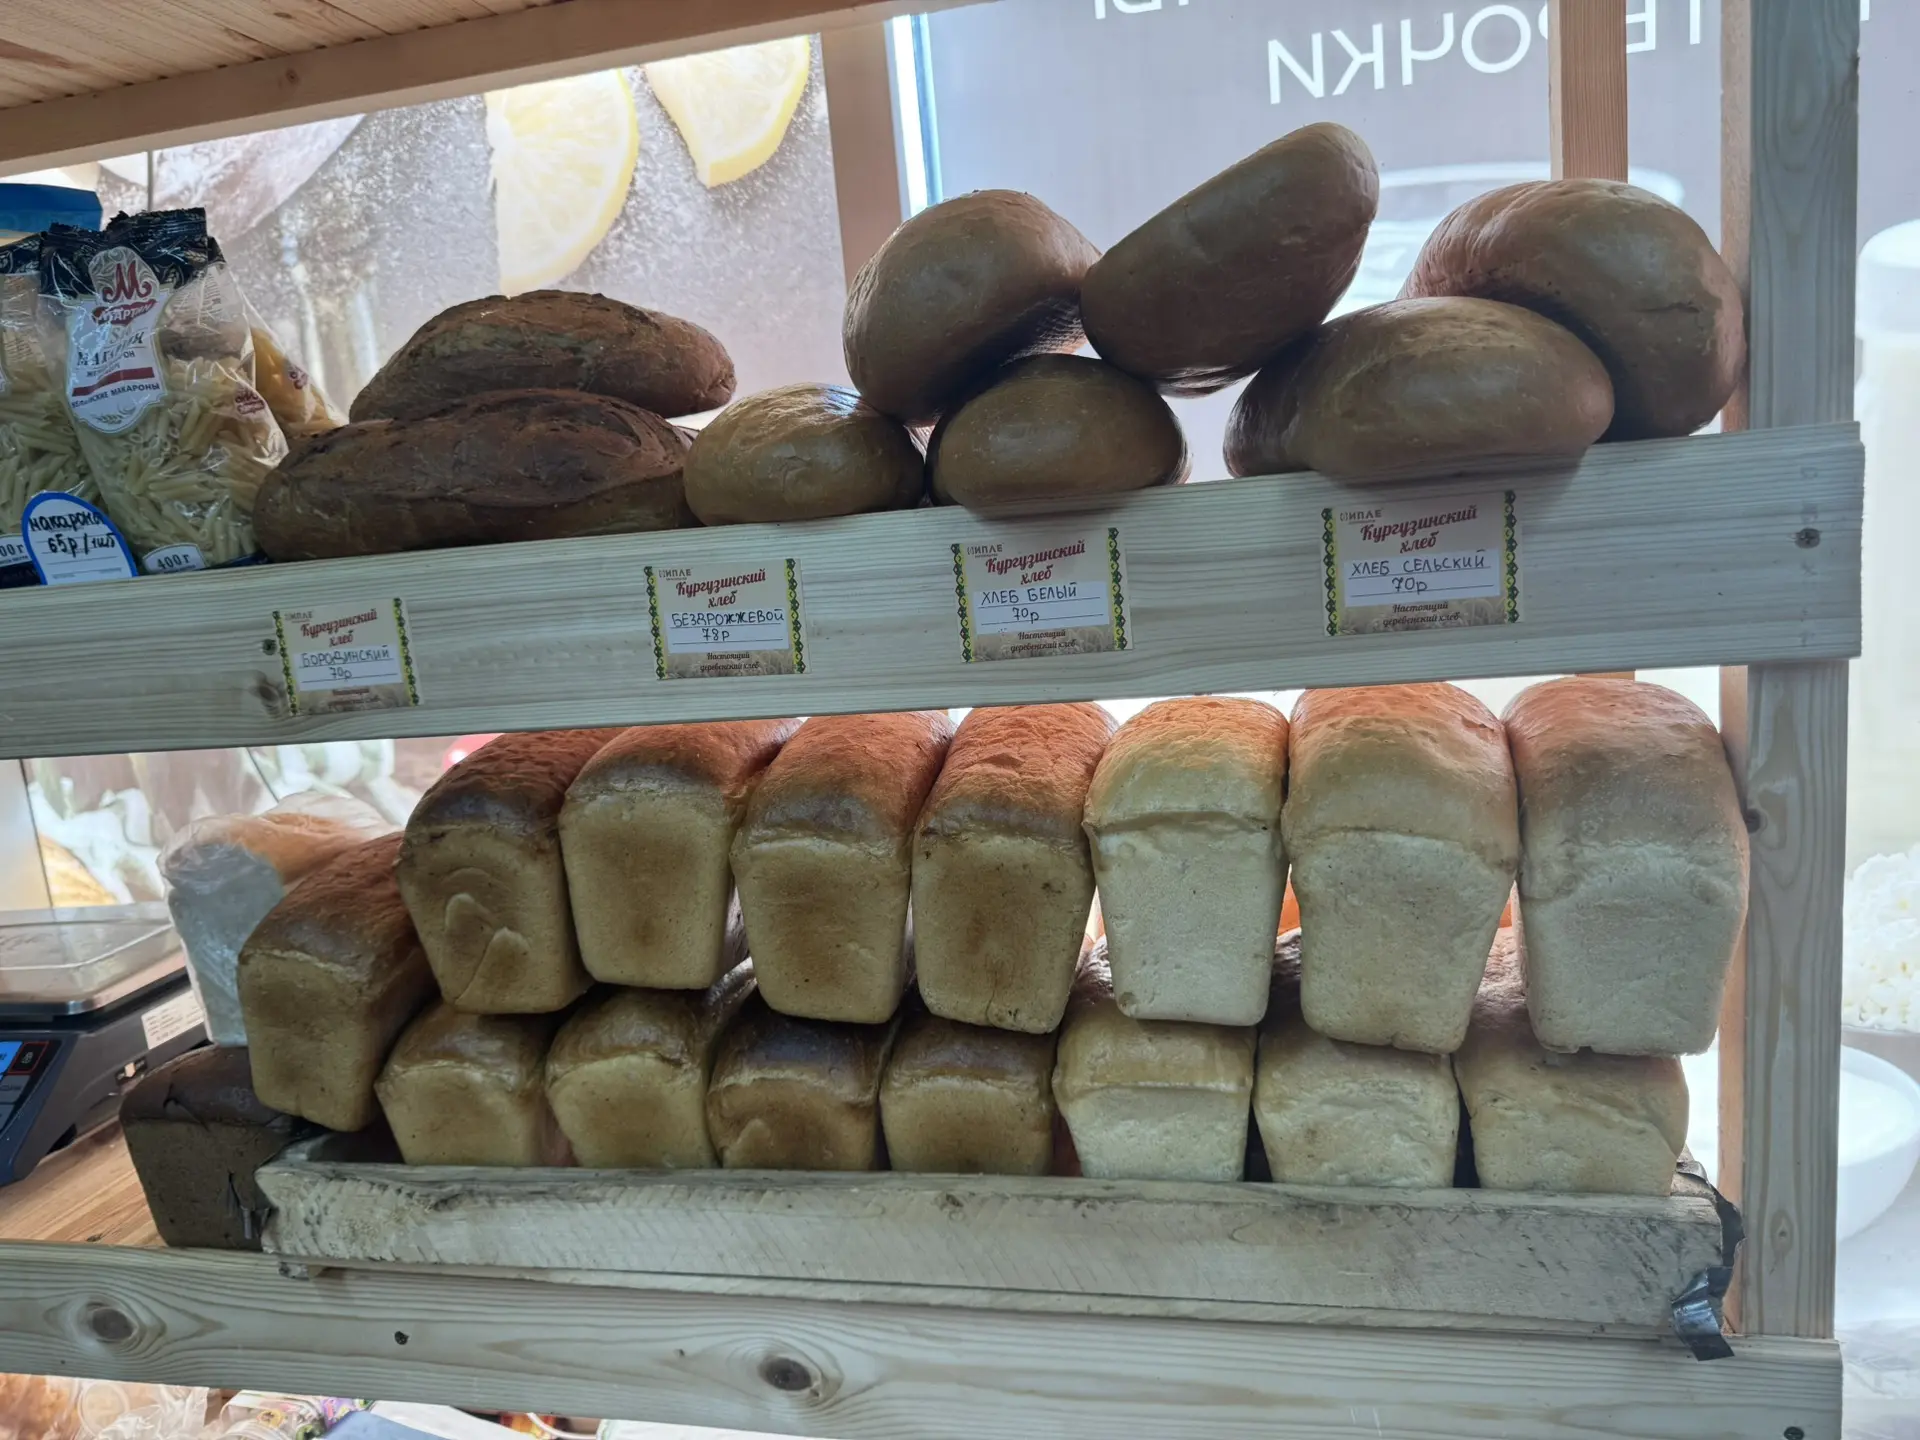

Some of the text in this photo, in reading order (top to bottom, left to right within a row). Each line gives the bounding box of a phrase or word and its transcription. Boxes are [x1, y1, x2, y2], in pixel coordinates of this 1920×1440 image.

[110, 383, 161, 396] МАКАРОНЫ
[1360, 505, 1478, 542] Кургузинский
[1400, 531, 1440, 553] хлеб
[157, 554, 182, 570] 400
[986, 539, 1086, 575] Кургузинский
[1351, 549, 1487, 576] ХЛЕБ СЕЛЬСКИЙ
[675, 568, 766, 598] Кургузинский
[1020, 564, 1054, 585] хлеб
[981, 582, 1078, 606] ХЛЕБ БЕЛЫЙ
[1391, 577, 1428, 594] 70р
[708, 590, 738, 608] хлеб
[301, 609, 378, 638] Кургузинский
[672, 609, 785, 627] БЕЗДРОЖЖЕВОЙ
[1012, 607, 1040, 624] 70р
[329, 630, 354, 647] хлеб
[702, 628, 730, 642] 78р
[302, 645, 390, 667] БОРОДИНСКИЙ
